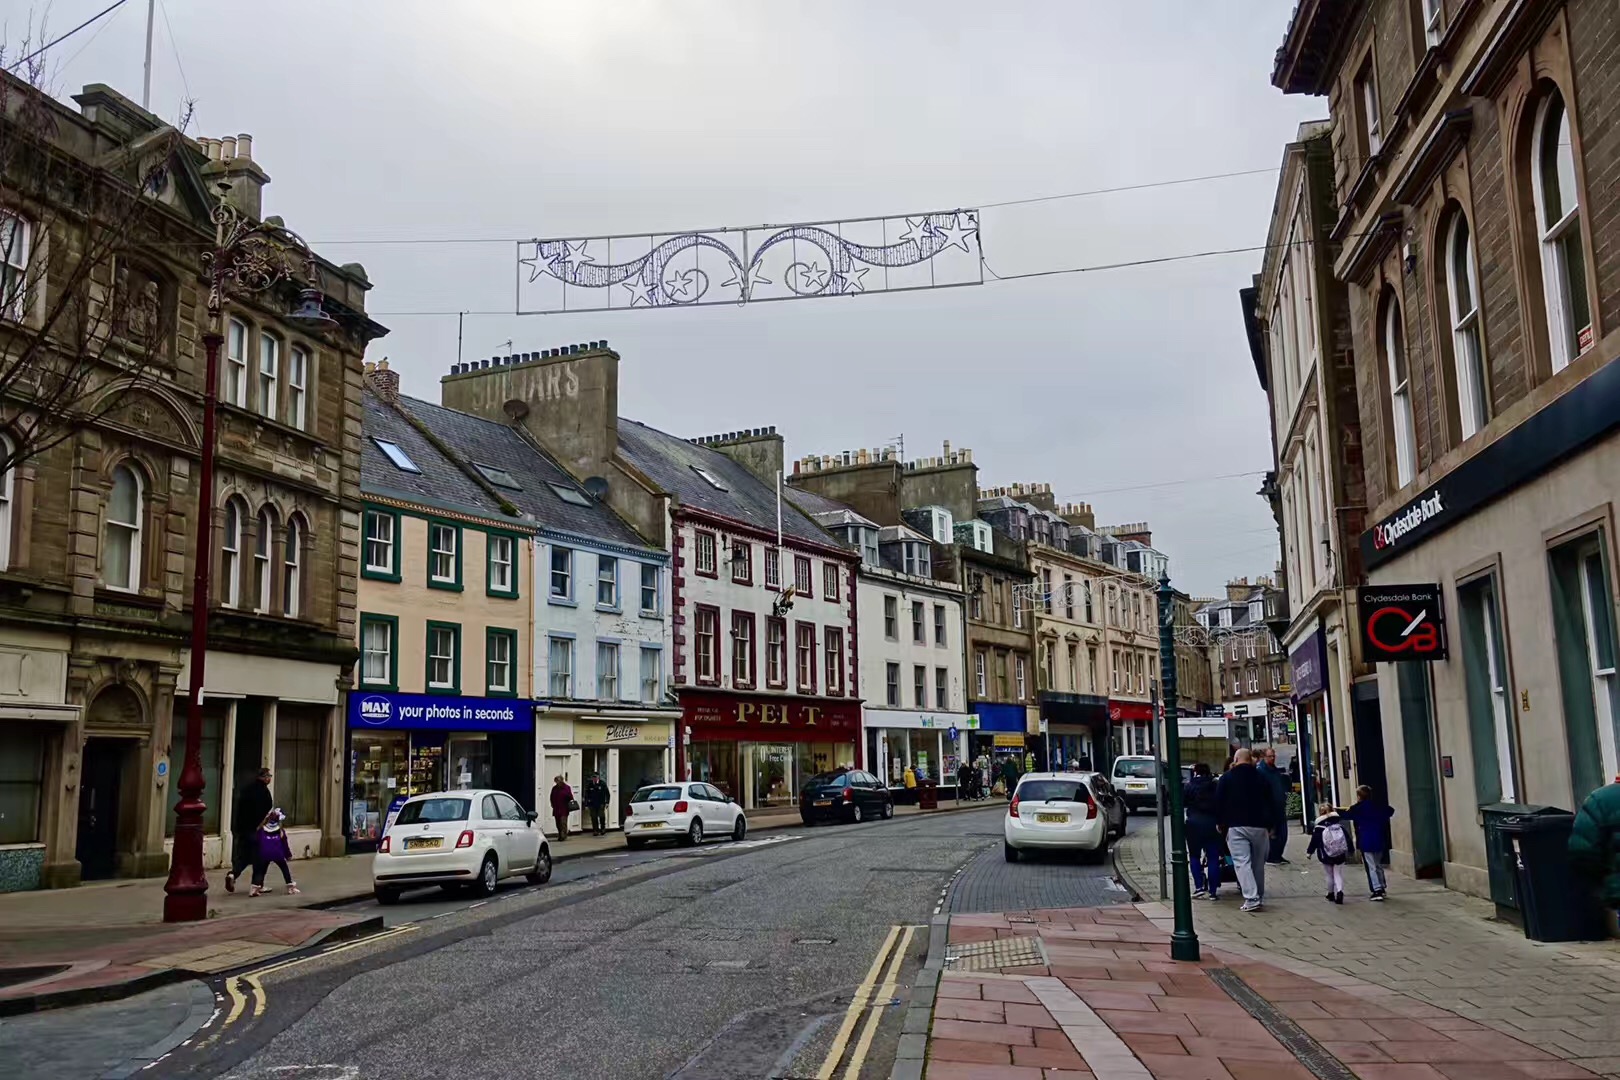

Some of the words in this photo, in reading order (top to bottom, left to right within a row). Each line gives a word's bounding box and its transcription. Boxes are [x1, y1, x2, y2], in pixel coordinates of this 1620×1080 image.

[1384, 505, 1421, 546] Clydesdale
[1421, 490, 1443, 522] Bank
[1364, 594, 1410, 603] Clydesdale
[1411, 593, 1432, 601] Bank
[361, 701, 390, 713] MAX
[399, 706, 424, 720] your
[425, 704, 461, 721] photos
[463, 706, 472, 719] in
[475, 707, 514, 720] seconds
[606, 724, 638, 740] Philips
